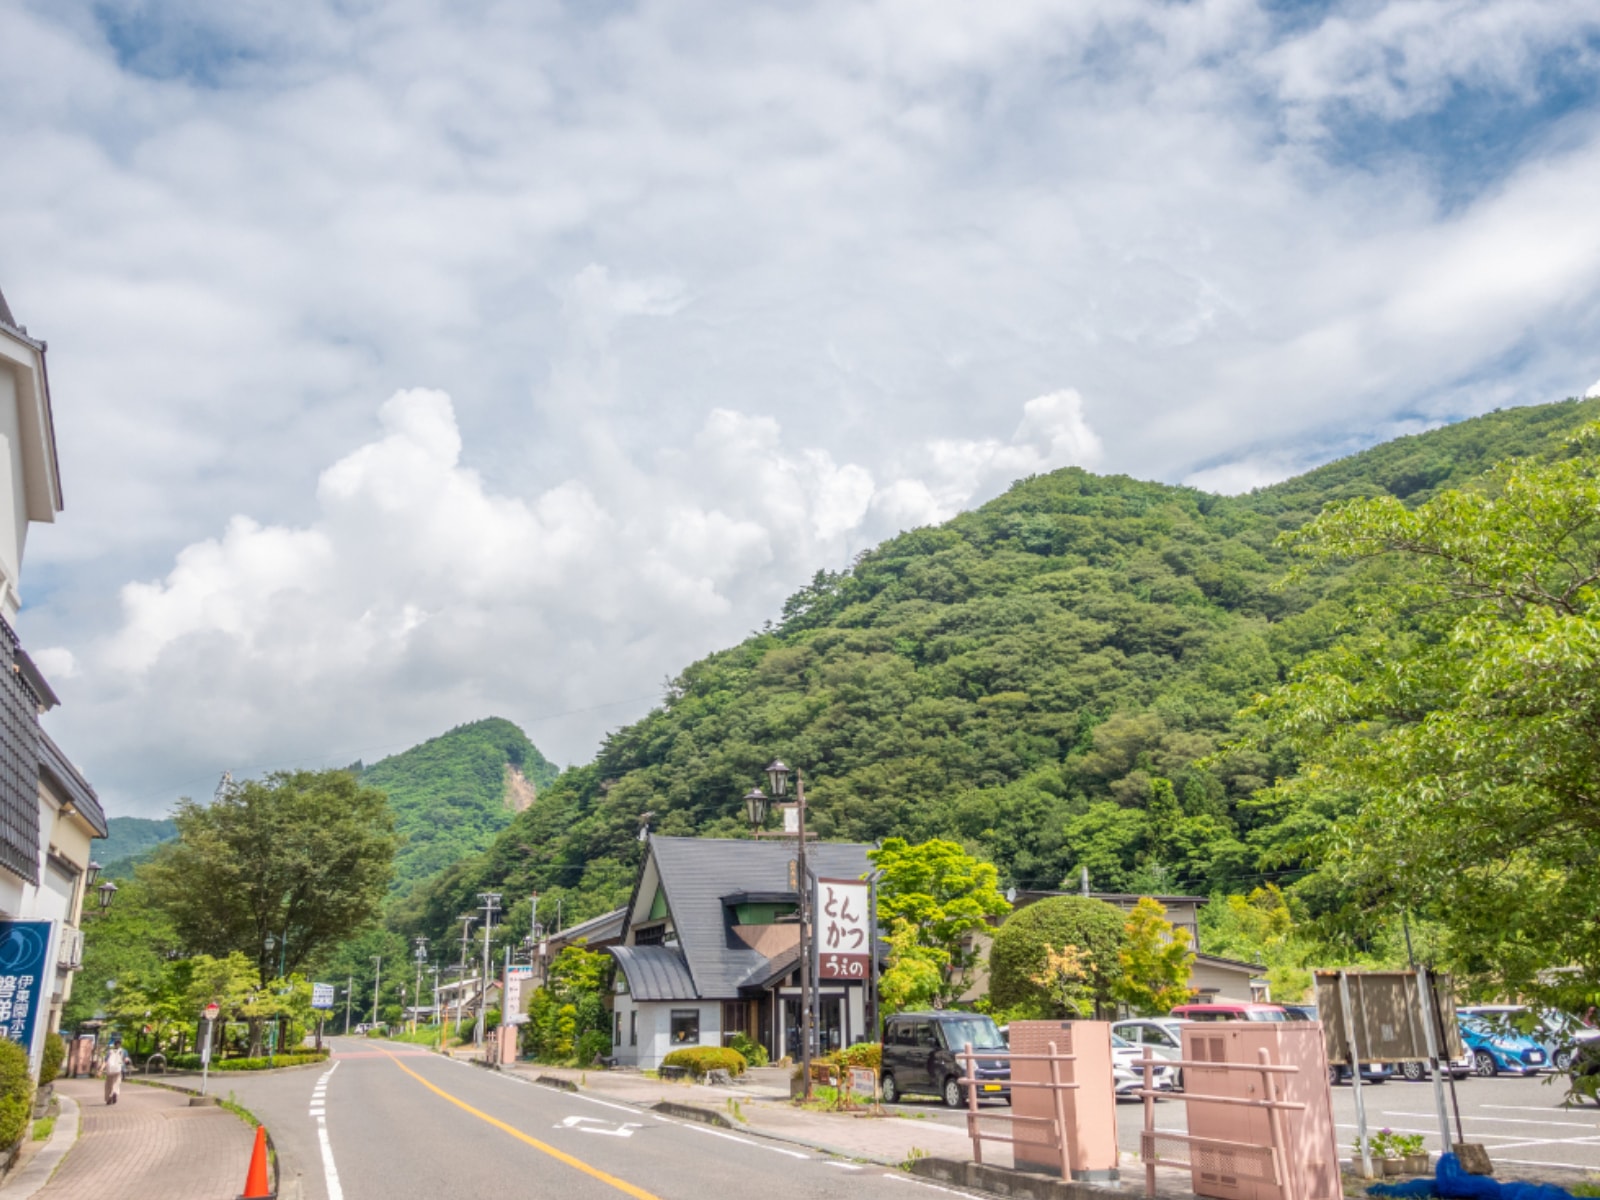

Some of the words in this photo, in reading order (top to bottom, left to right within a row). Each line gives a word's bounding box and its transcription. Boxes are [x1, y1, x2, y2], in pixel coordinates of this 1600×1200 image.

[824, 886, 860, 923] とん
[826, 920, 865, 949] かつ
[825, 954, 863, 977] うえの
